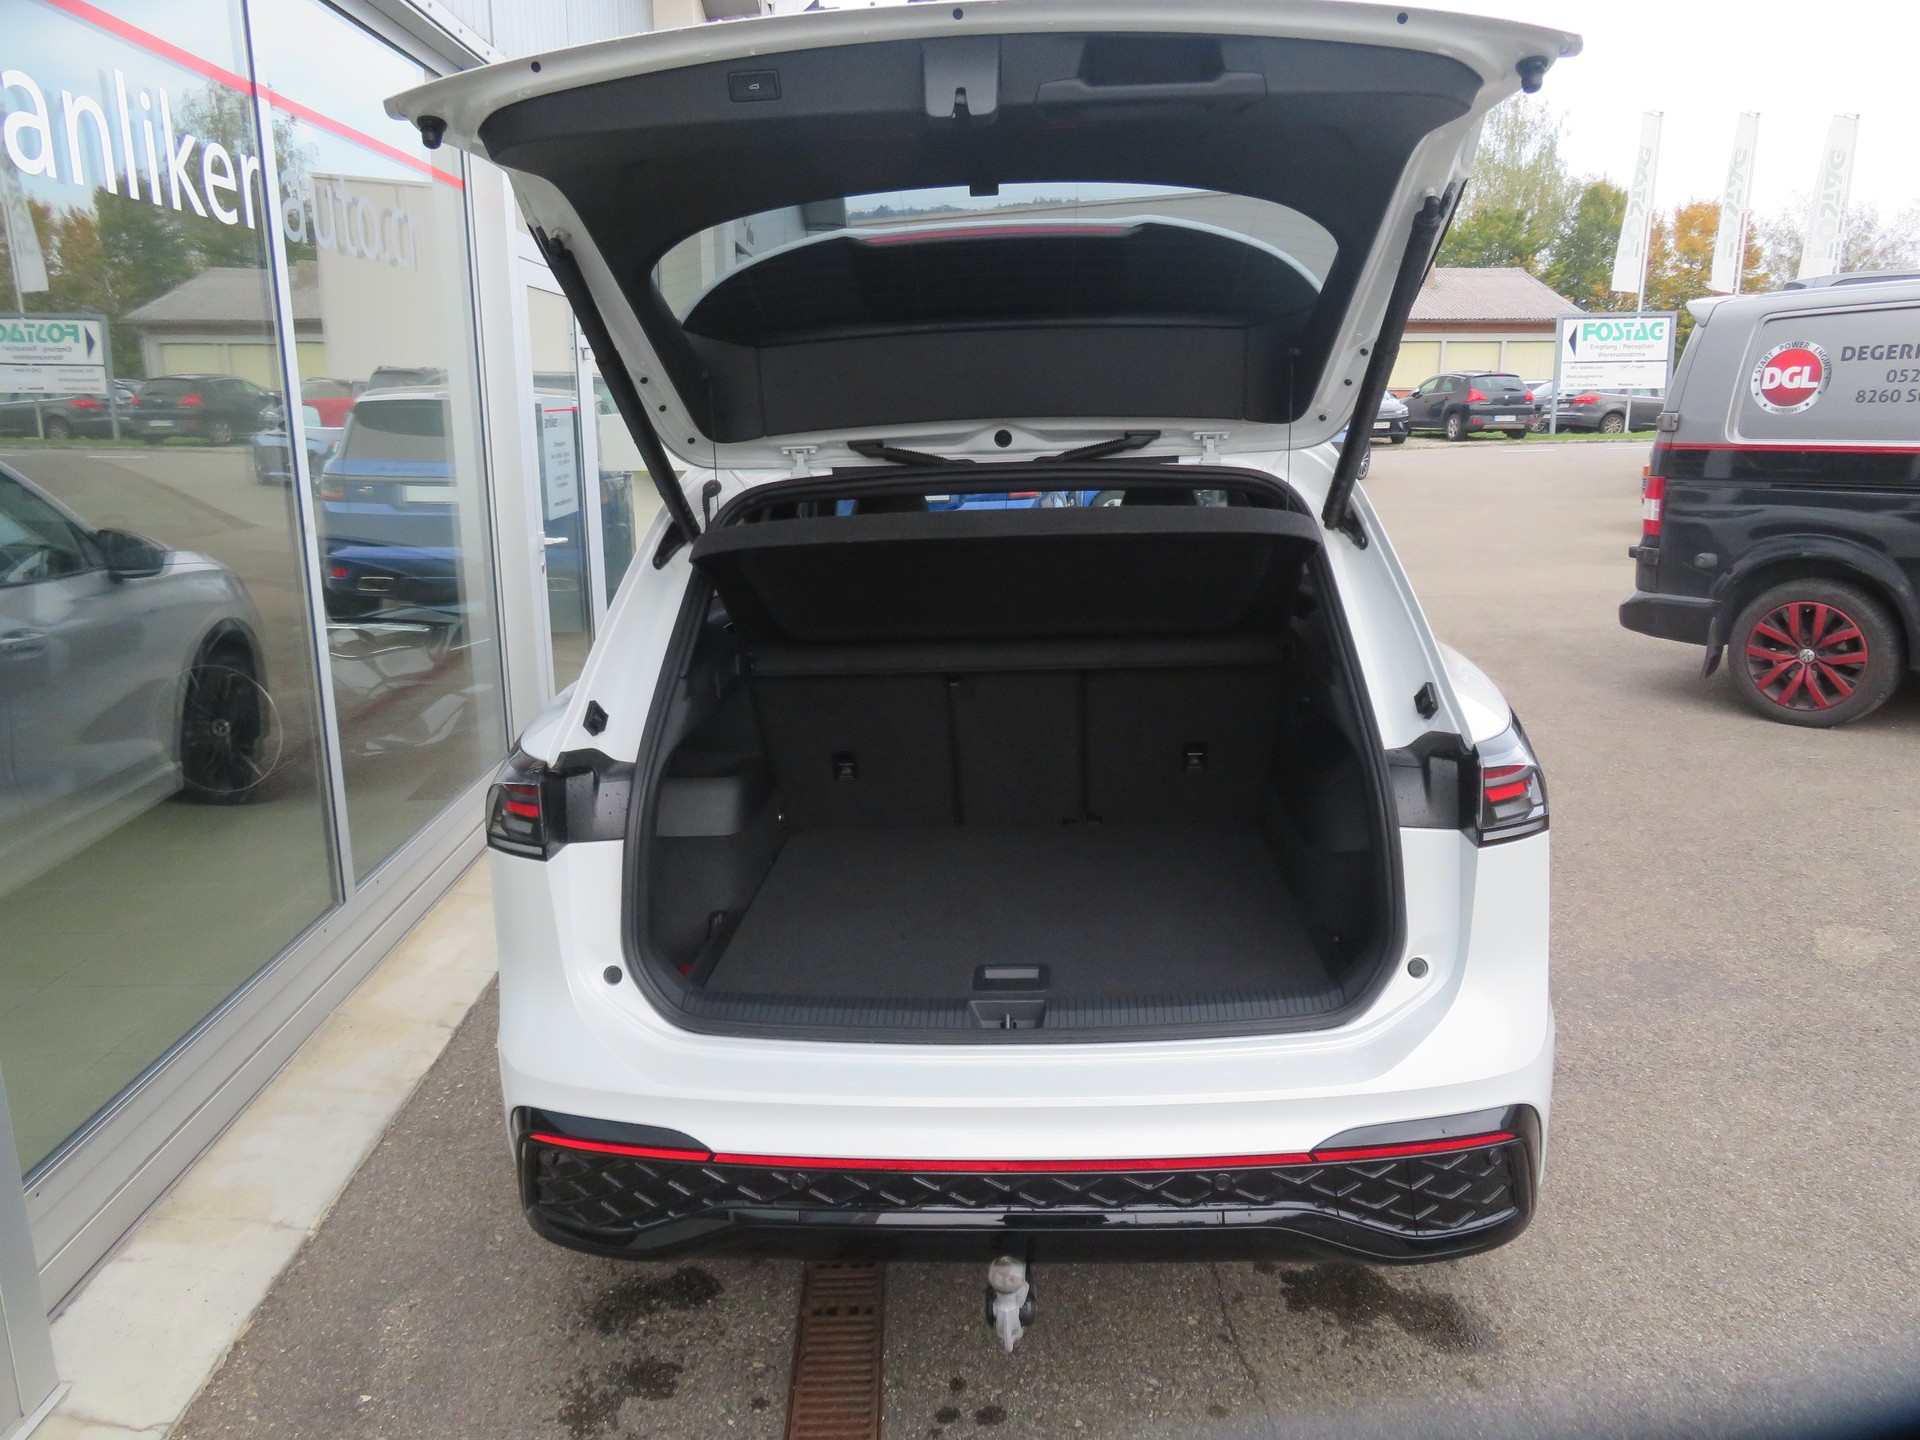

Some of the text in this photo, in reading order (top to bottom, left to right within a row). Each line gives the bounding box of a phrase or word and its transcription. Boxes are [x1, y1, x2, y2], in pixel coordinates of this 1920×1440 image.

[2, 68, 260, 230] anliker
[1582, 321, 1664, 341] FOSTAG
[1755, 341, 1831, 374] START POWER ENGINE
[1761, 366, 1819, 390] DGL
[1886, 368, 1920, 383] 052
[1855, 388, 1920, 403] 8260 S
